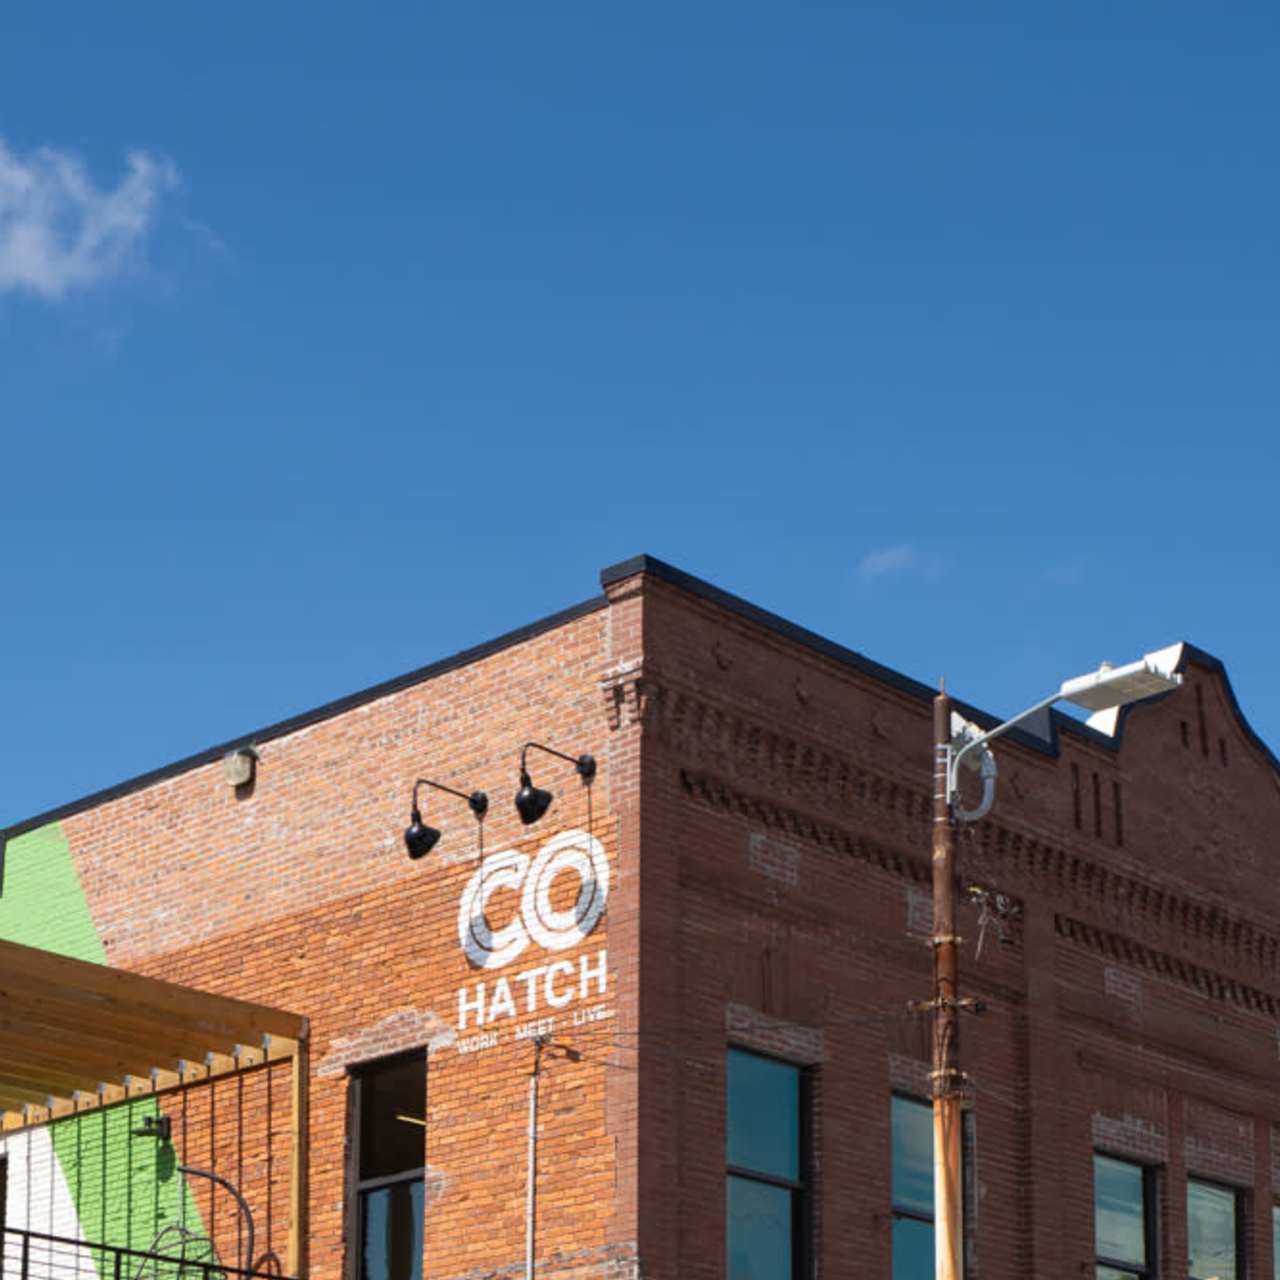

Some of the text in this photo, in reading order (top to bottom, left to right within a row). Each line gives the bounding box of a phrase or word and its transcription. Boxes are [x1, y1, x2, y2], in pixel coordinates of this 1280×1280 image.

[457, 829, 609, 967] CO
[457, 949, 608, 1031] HATCH
[457, 1033, 498, 1055] WORK
[515, 1016, 556, 1040] MEET
